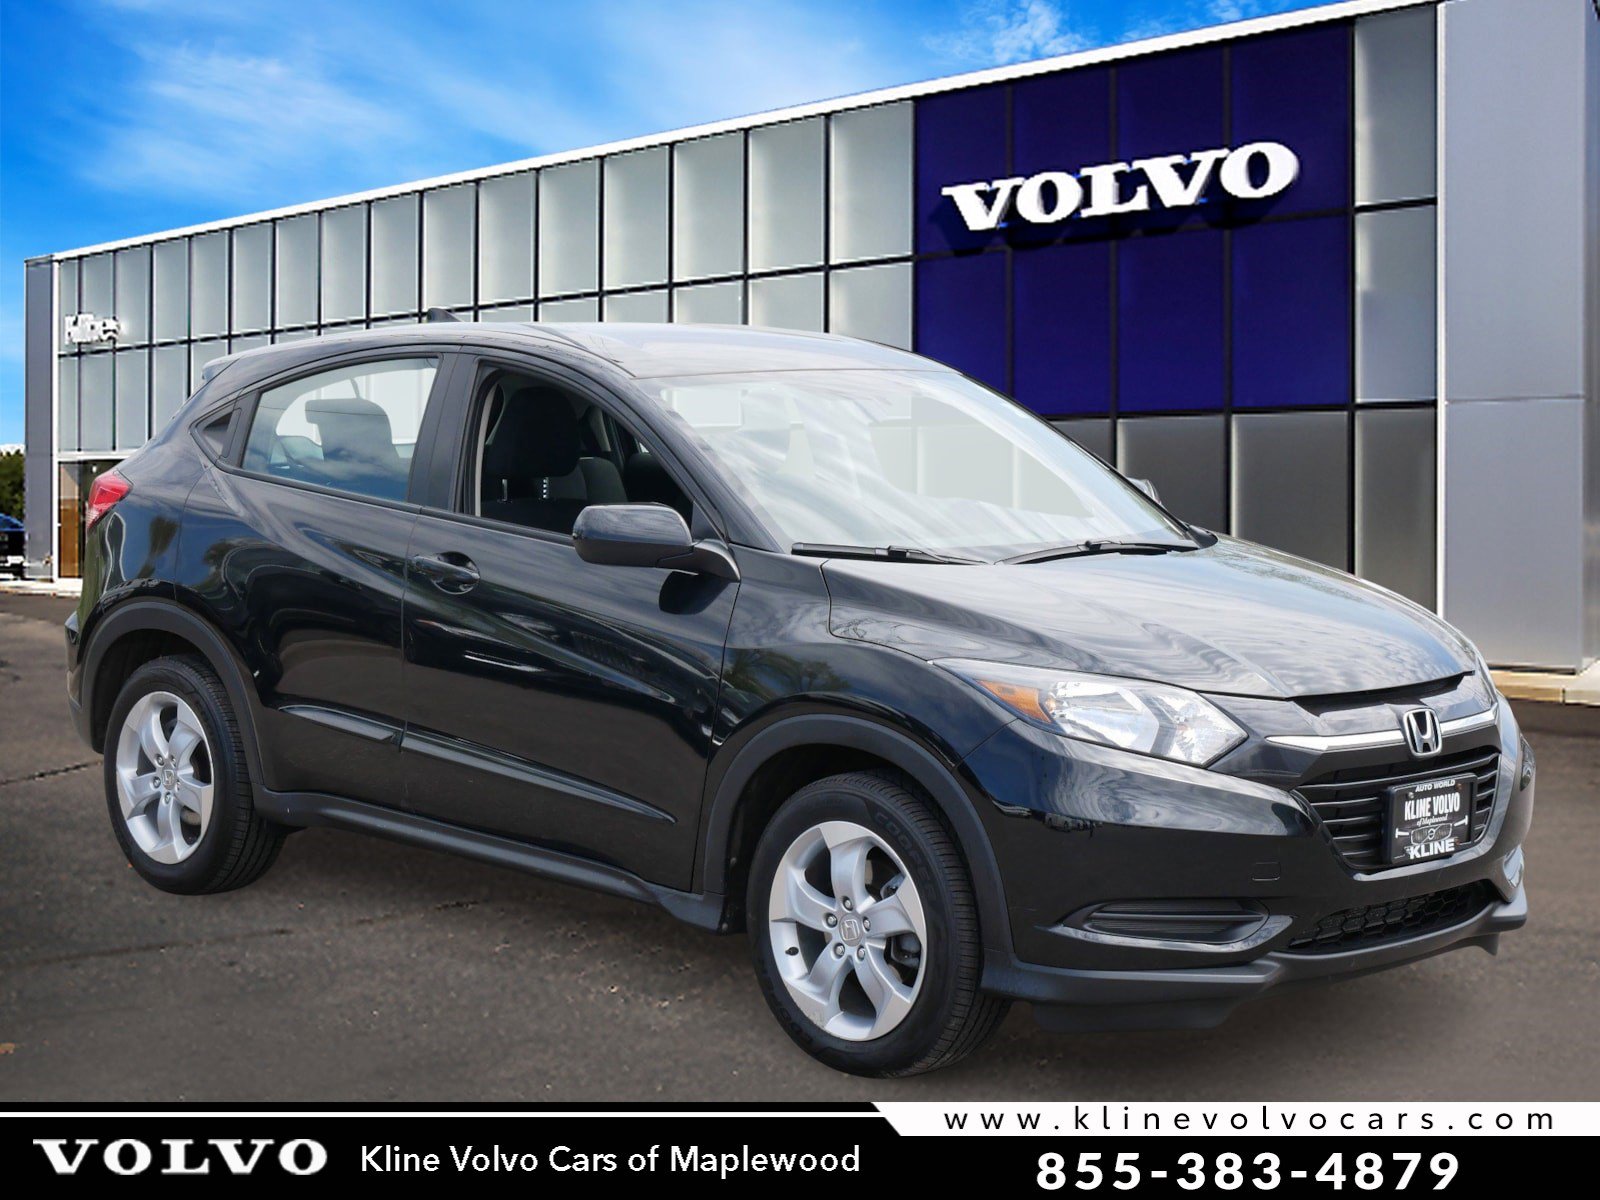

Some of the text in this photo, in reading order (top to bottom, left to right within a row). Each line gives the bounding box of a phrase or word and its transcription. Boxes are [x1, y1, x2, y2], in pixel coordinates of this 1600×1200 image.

[941, 142, 1299, 230] VOLVO
[1415, 779, 1456, 793] AUTO WORLD
[1404, 792, 1460, 821] KLINE VOLVO
[1409, 838, 1456, 860] KLINE
